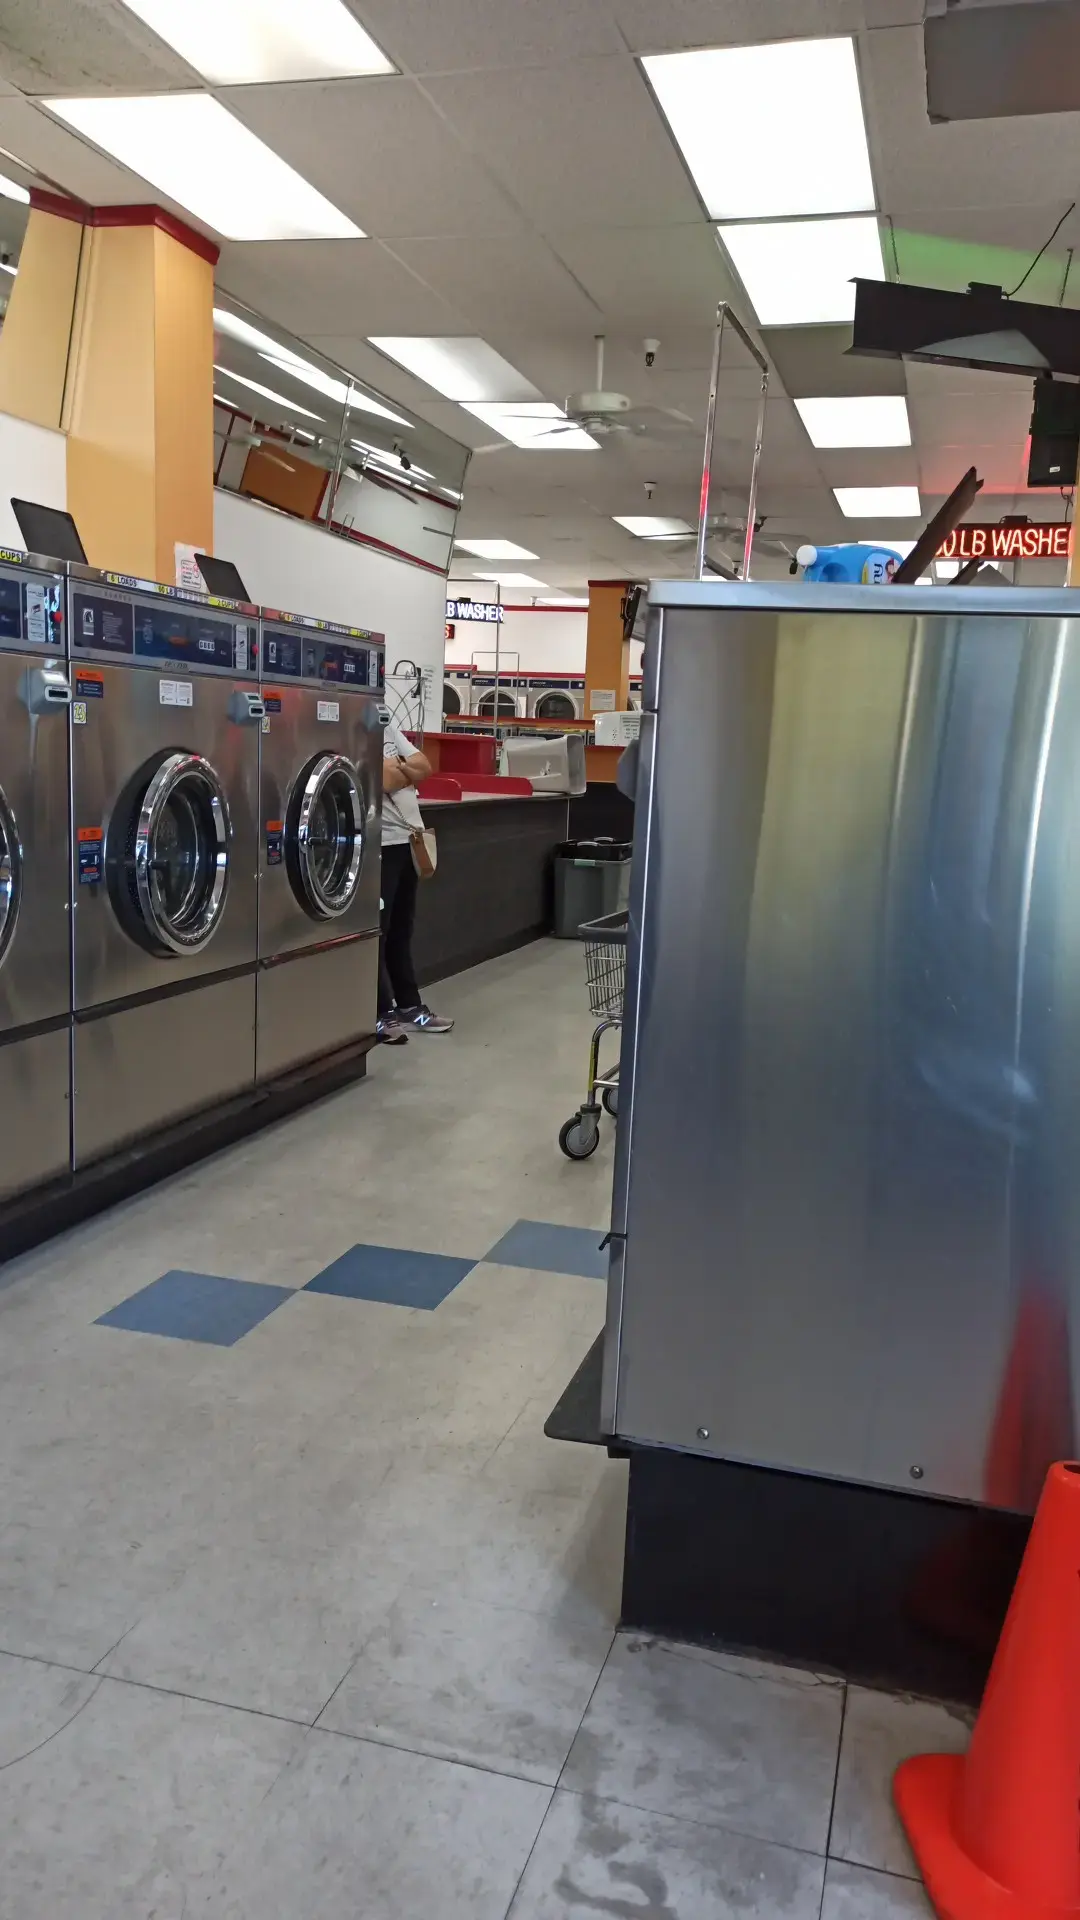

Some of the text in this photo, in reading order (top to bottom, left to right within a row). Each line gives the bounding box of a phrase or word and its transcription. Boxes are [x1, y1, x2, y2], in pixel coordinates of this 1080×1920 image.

[960, 529, 987, 556] LB
[991, 527, 1072, 557] WASHE
[0, 550, 21, 562] CUPS
[117, 576, 137, 587] LOADS
[456, 602, 504, 621] WASHER
